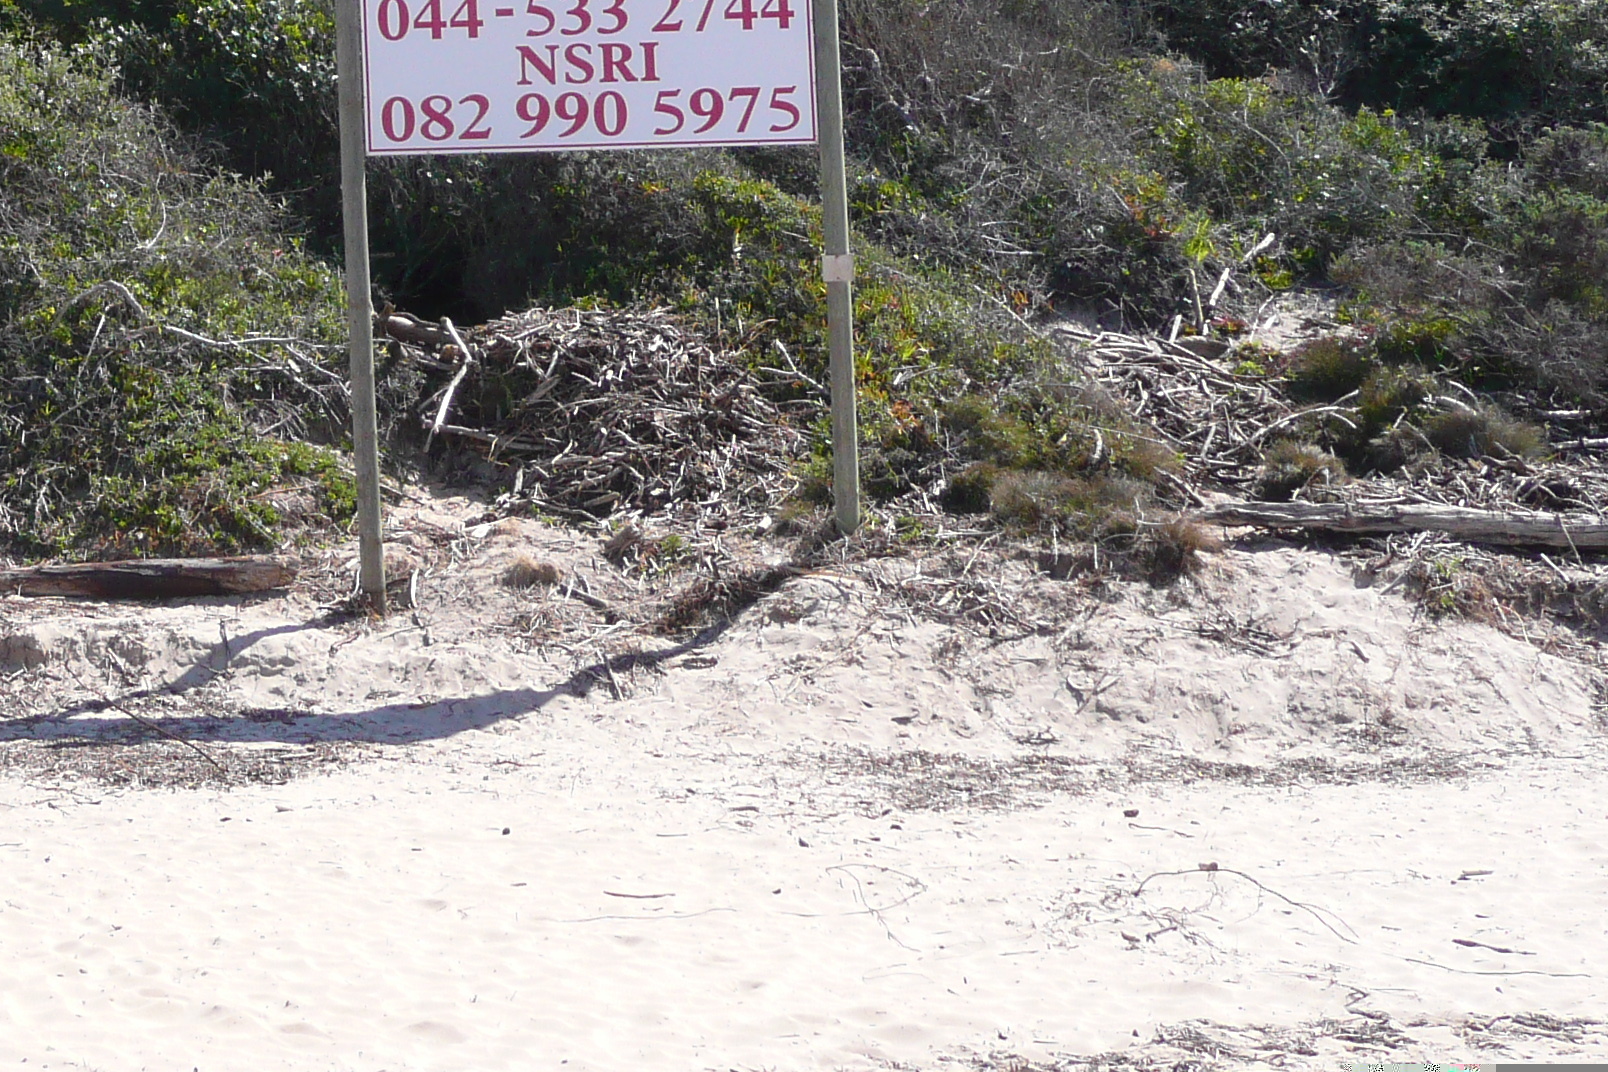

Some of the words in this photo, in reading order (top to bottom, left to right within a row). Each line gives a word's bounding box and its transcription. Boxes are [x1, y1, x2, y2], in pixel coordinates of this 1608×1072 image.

[516, 42, 660, 86] NSRI
[381, 93, 492, 143] 082
[515, 90, 628, 139] 990
[653, 85, 800, 136] 5975
